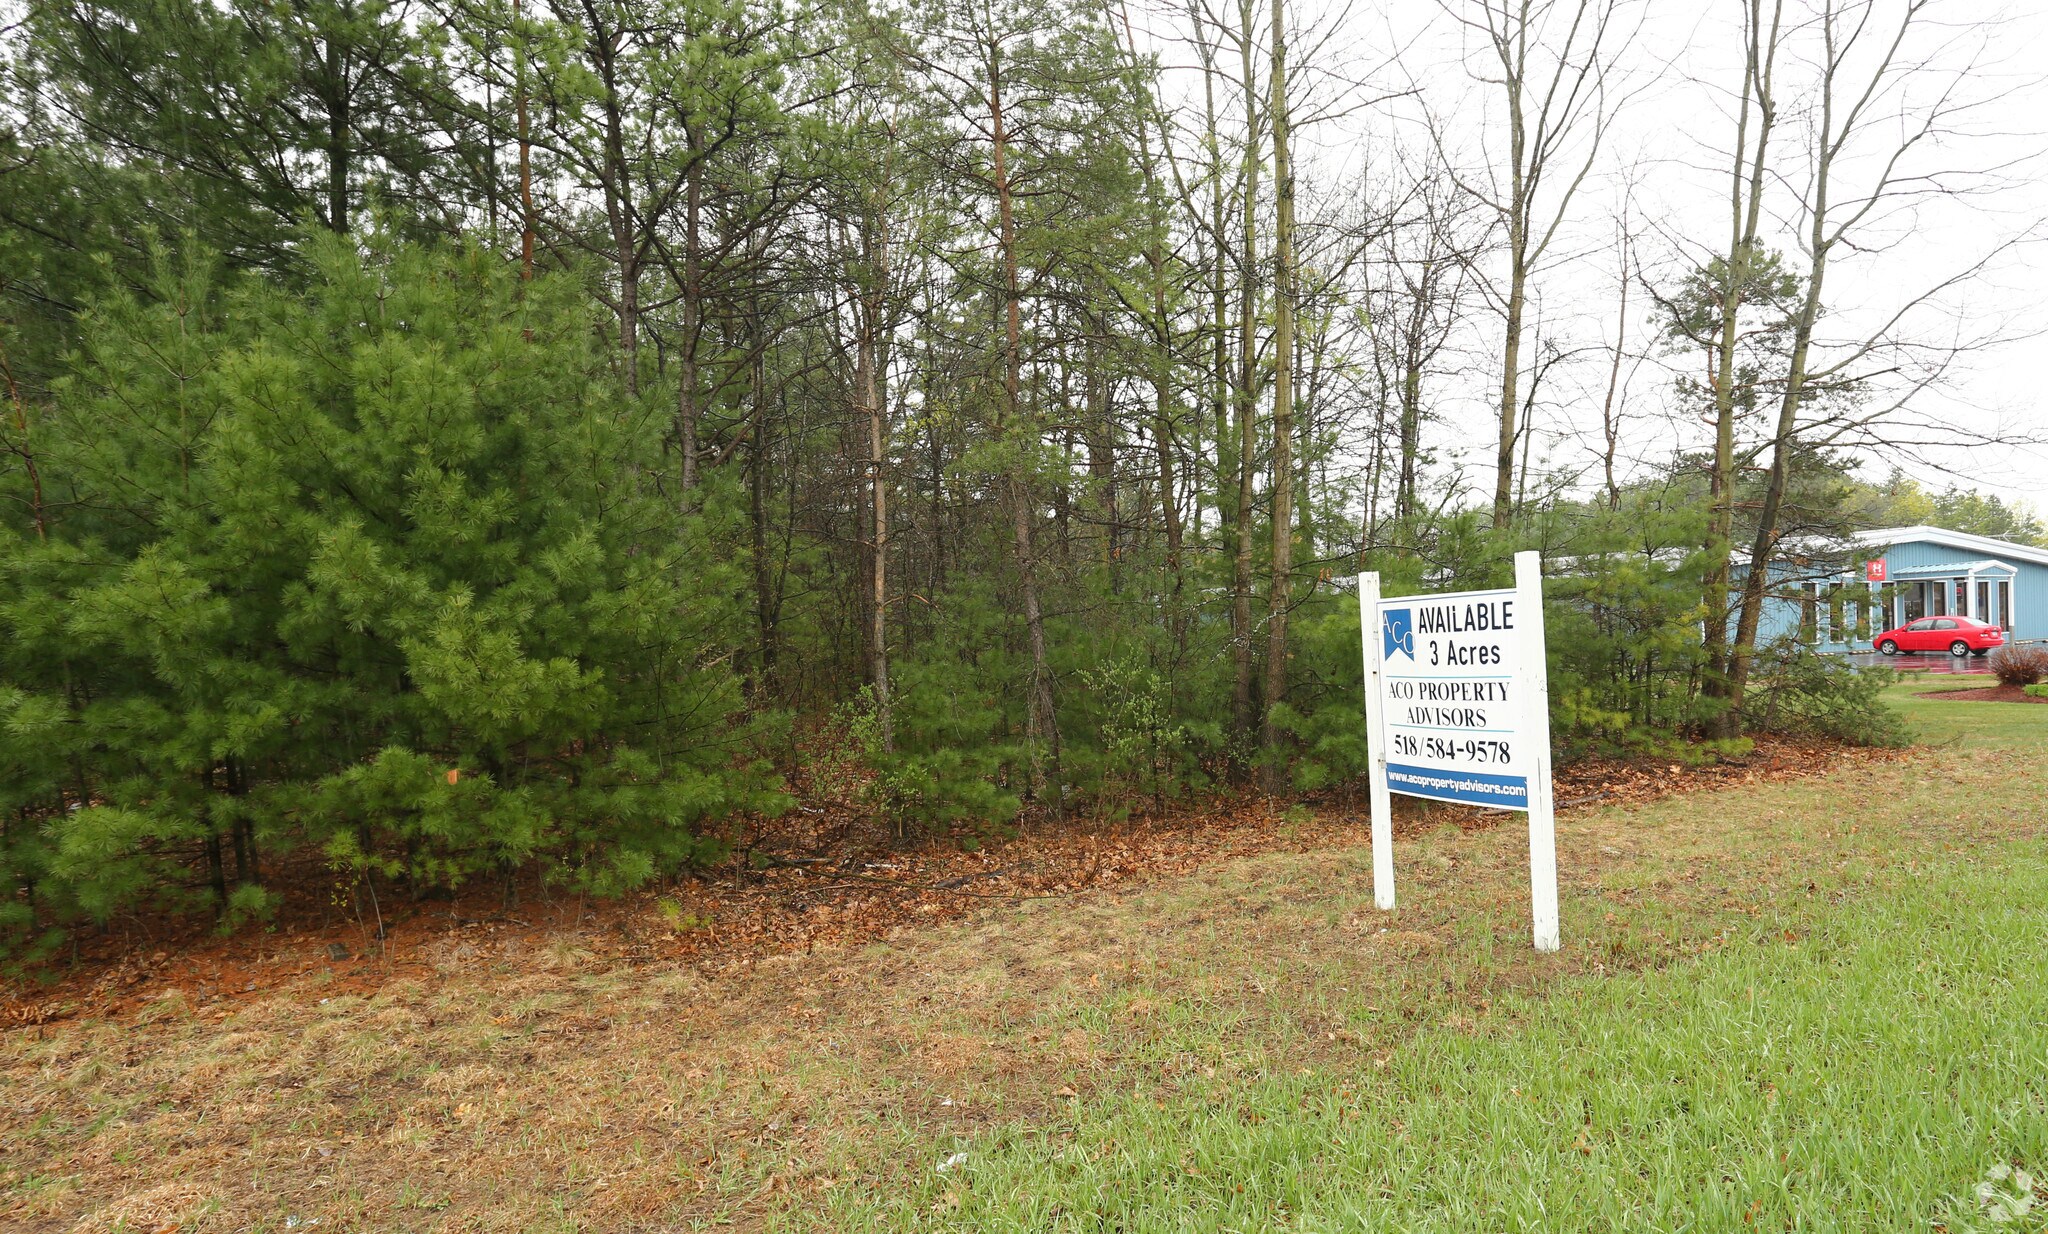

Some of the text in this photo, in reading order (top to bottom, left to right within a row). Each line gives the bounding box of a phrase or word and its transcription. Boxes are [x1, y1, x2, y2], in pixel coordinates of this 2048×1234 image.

[1419, 601, 1513, 633] AVAILABLE
[1383, 612, 1415, 654] ACO
[1429, 640, 1501, 666] 3 Acres
[1388, 681, 1510, 701] ACO PROPERTY
[1406, 706, 1487, 728] ADVISORS
[1394, 734, 1511, 764] 518/584-9578
[1388, 770, 1526, 797] www.acopropertyadvisors.com
